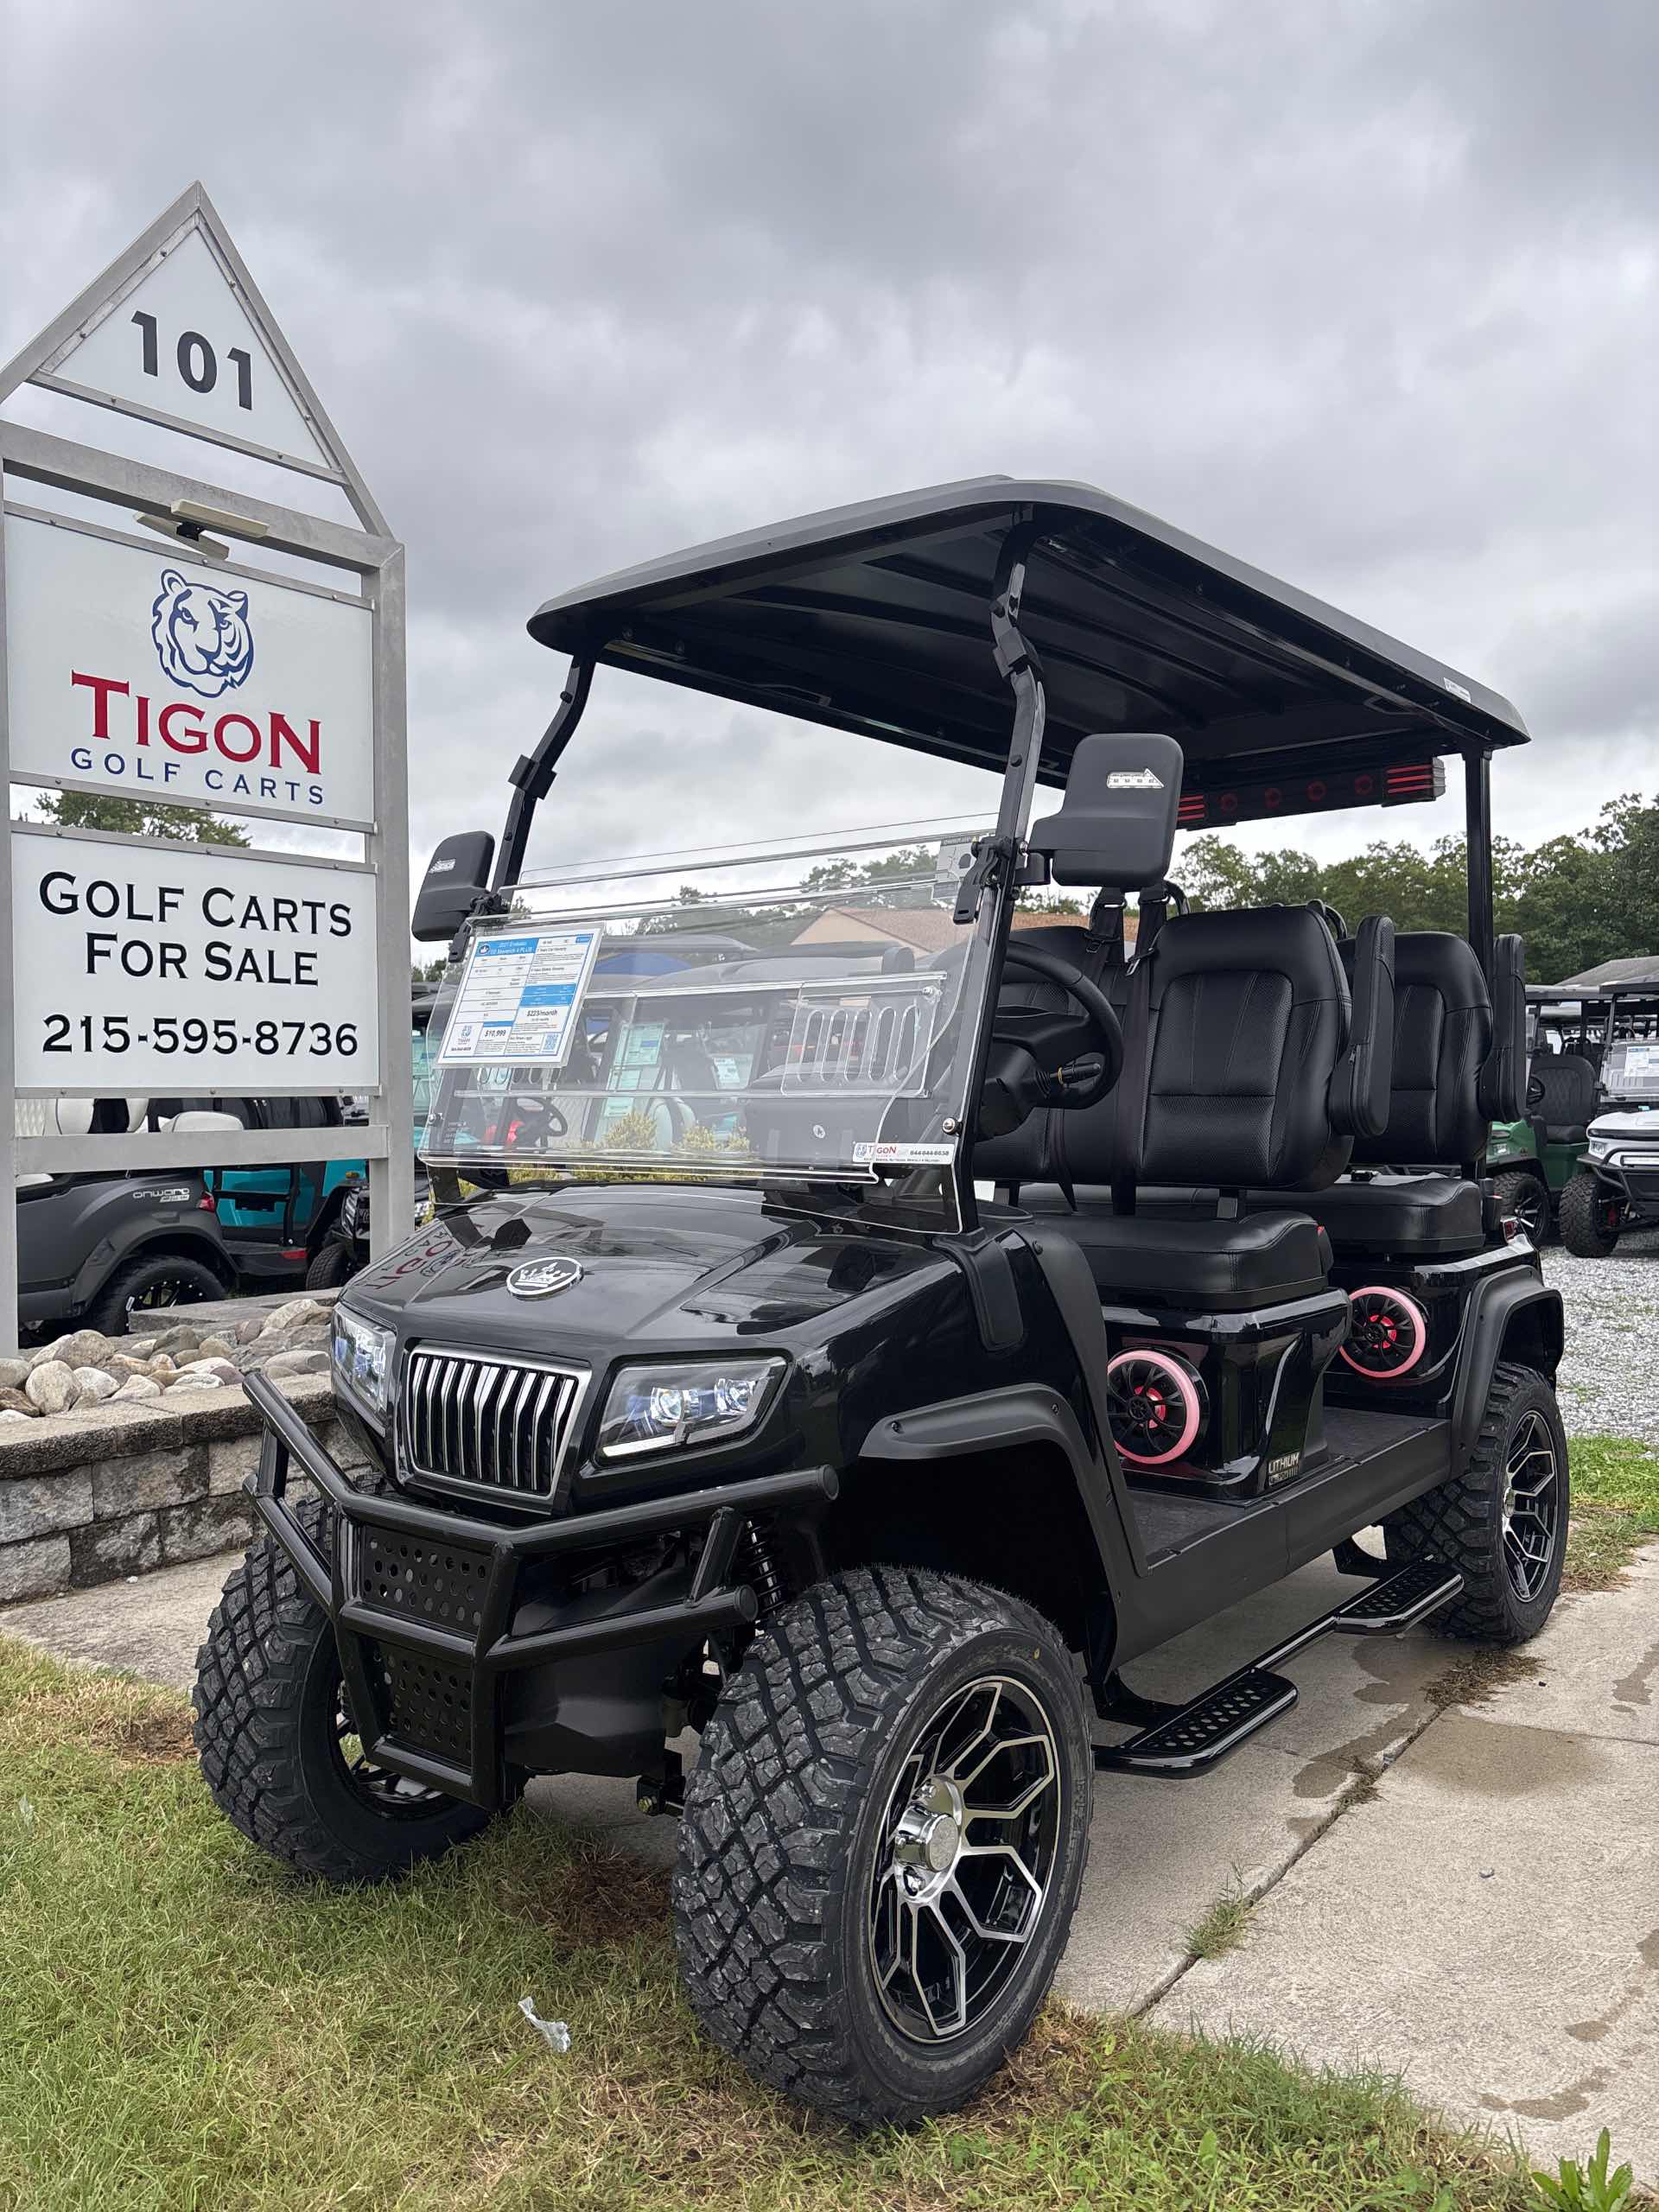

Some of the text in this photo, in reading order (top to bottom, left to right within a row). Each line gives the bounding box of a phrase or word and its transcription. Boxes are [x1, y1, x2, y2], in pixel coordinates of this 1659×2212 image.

[131, 311, 252, 410] 101
[71, 671, 321, 774] TIGON
[71, 747, 324, 805] GOLF CARTS
[39, 871, 352, 938] GOLF CARTS
[86, 931, 319, 986] FOR SALE
[42, 1014, 358, 1057] 215-595-8736
[868, 1146, 897, 1154] TGON
[1268, 1452, 1300, 1474] LITHIUM
